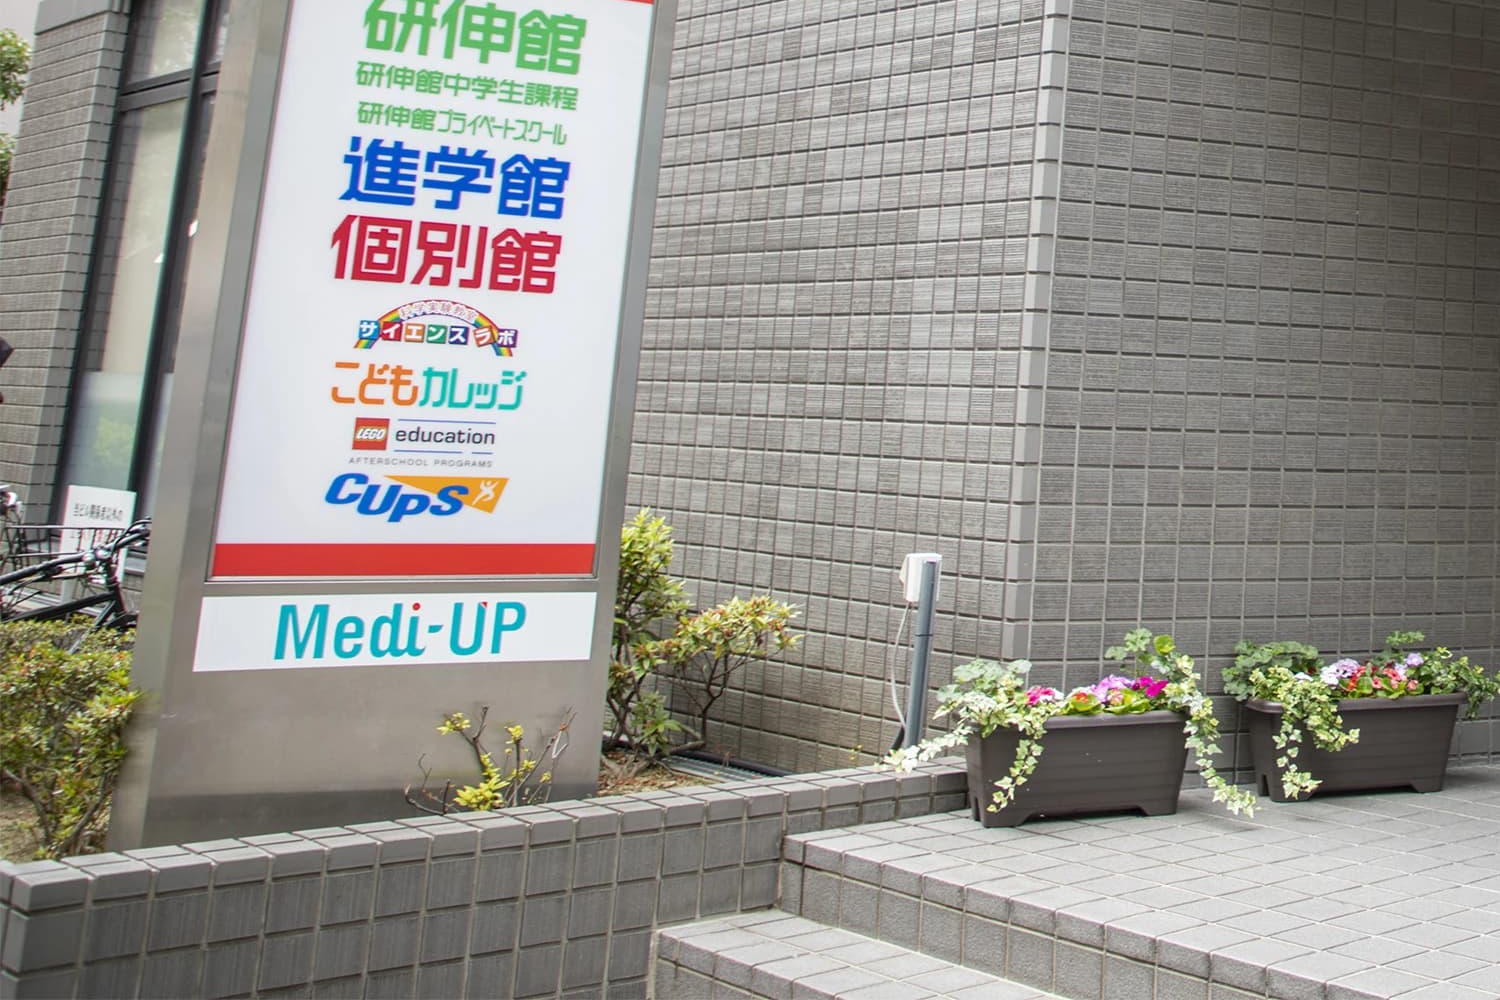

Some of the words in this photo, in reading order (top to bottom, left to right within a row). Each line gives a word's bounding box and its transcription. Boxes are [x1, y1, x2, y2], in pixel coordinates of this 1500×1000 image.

[355, 60, 578, 111] 研伸館中学生課程
[357, 101, 567, 146] 研伸館プライベートスクール
[338, 137, 570, 220] 進学館
[331, 214, 563, 294] 個別館
[358, 321, 517, 347] サイエンスラボ
[331, 362, 527, 411] こどもカレッジ
[355, 427, 387, 441] LEGO
[395, 426, 496, 445] education
[348, 457, 429, 467] AFTERSCHOOL
[434, 459, 493, 468] PROGRAMS
[273, 601, 527, 661] Medi-UP
